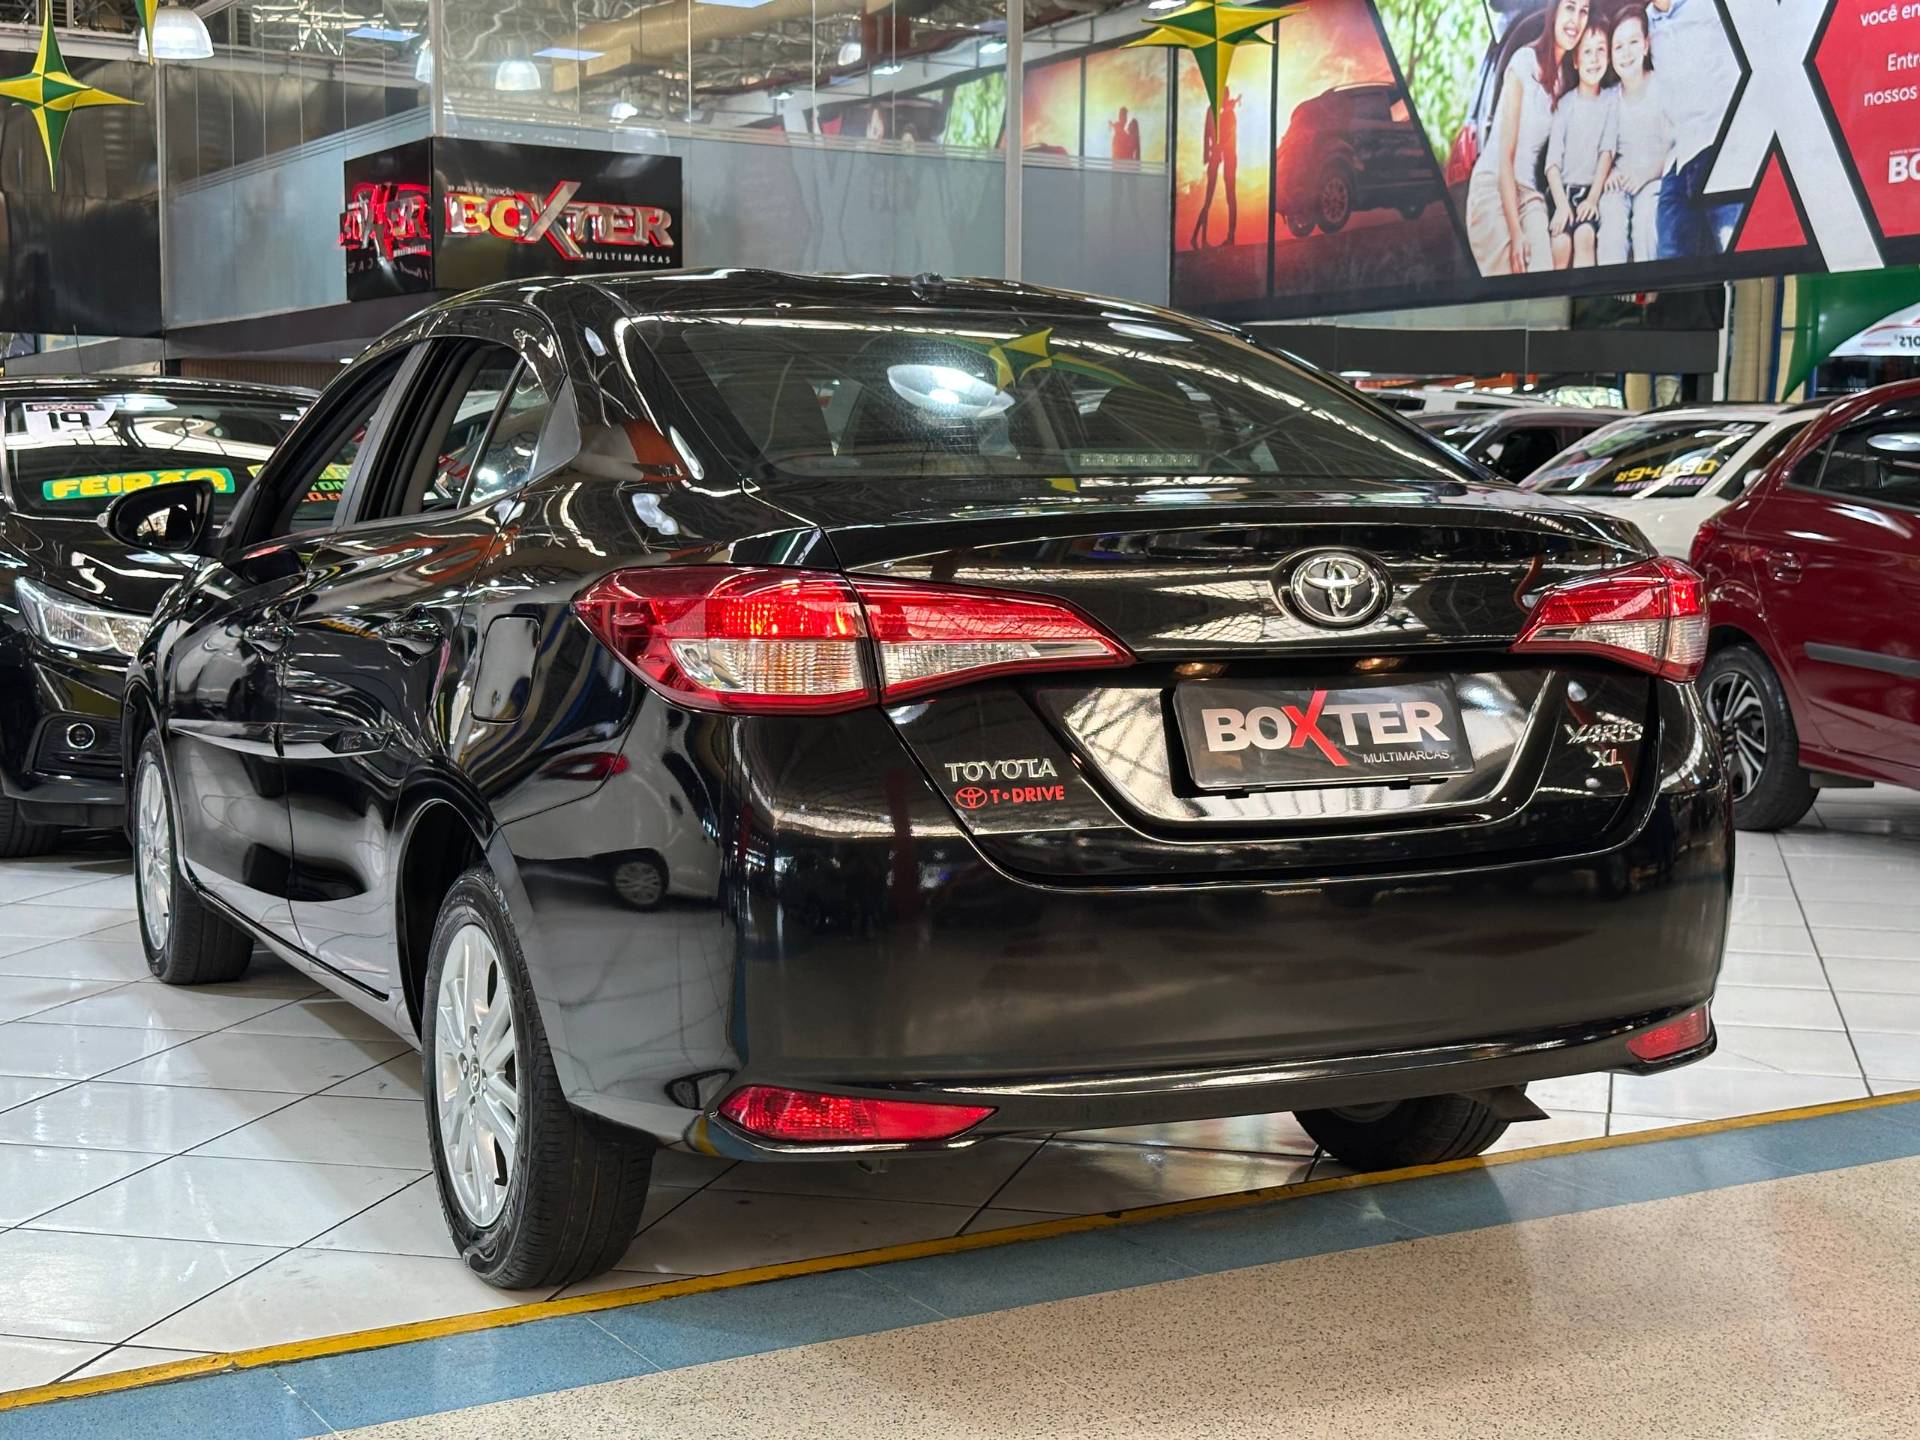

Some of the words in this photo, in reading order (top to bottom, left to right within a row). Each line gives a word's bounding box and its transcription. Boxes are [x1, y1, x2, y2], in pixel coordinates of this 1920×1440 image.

[1860, 4, 1898, 26] você
[1887, 53, 1920, 72] Entr
[1863, 85, 1918, 107] nossos
[444, 180, 674, 261] BOXTER
[585, 251, 672, 264] MULTIMARCAS
[47, 411, 91, 431] 19
[1613, 476, 1708, 492] AUTOTICO
[1201, 688, 1451, 767] BOXTER
[1563, 723, 1644, 745] YARIS
[1363, 750, 1451, 764] MULTIMARCAS
[1591, 748, 1623, 768] XL
[944, 757, 1058, 783] TOYOTA
